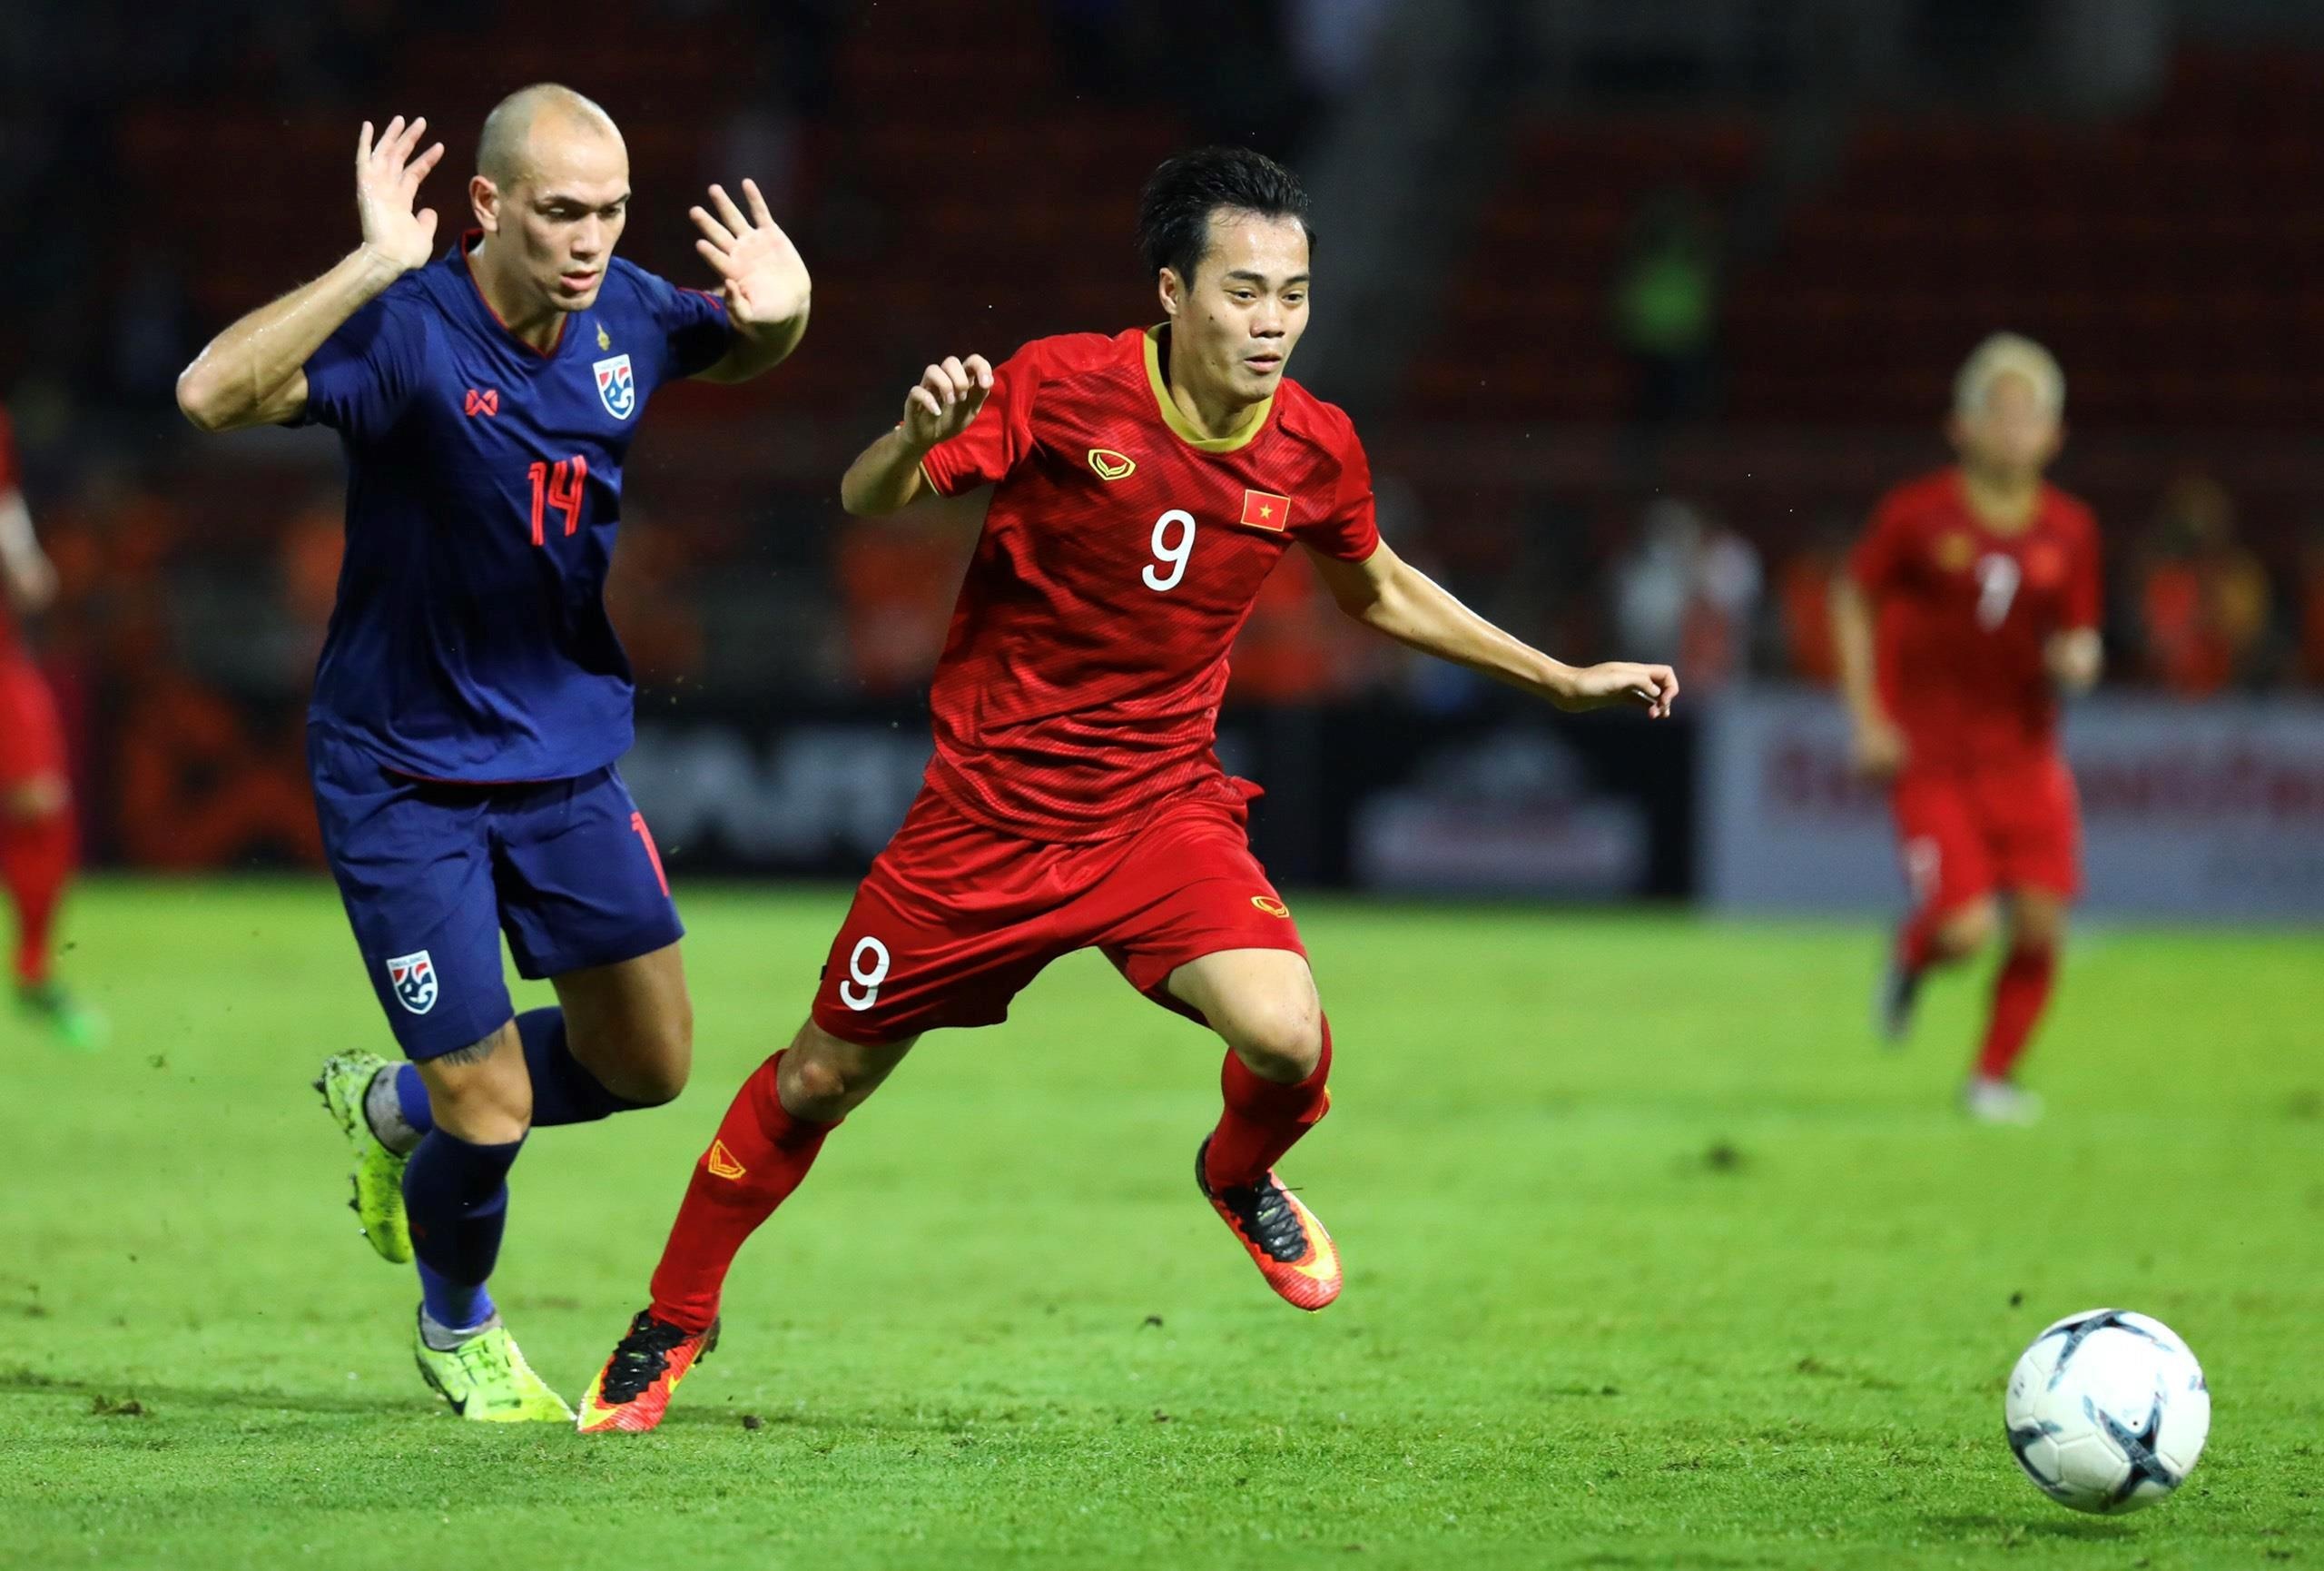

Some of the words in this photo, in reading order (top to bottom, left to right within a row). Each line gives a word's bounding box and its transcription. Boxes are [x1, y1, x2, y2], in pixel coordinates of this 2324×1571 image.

[528, 455, 588, 546] 14
[1141, 509, 1196, 592] 9
[840, 935, 891, 1012] 9
